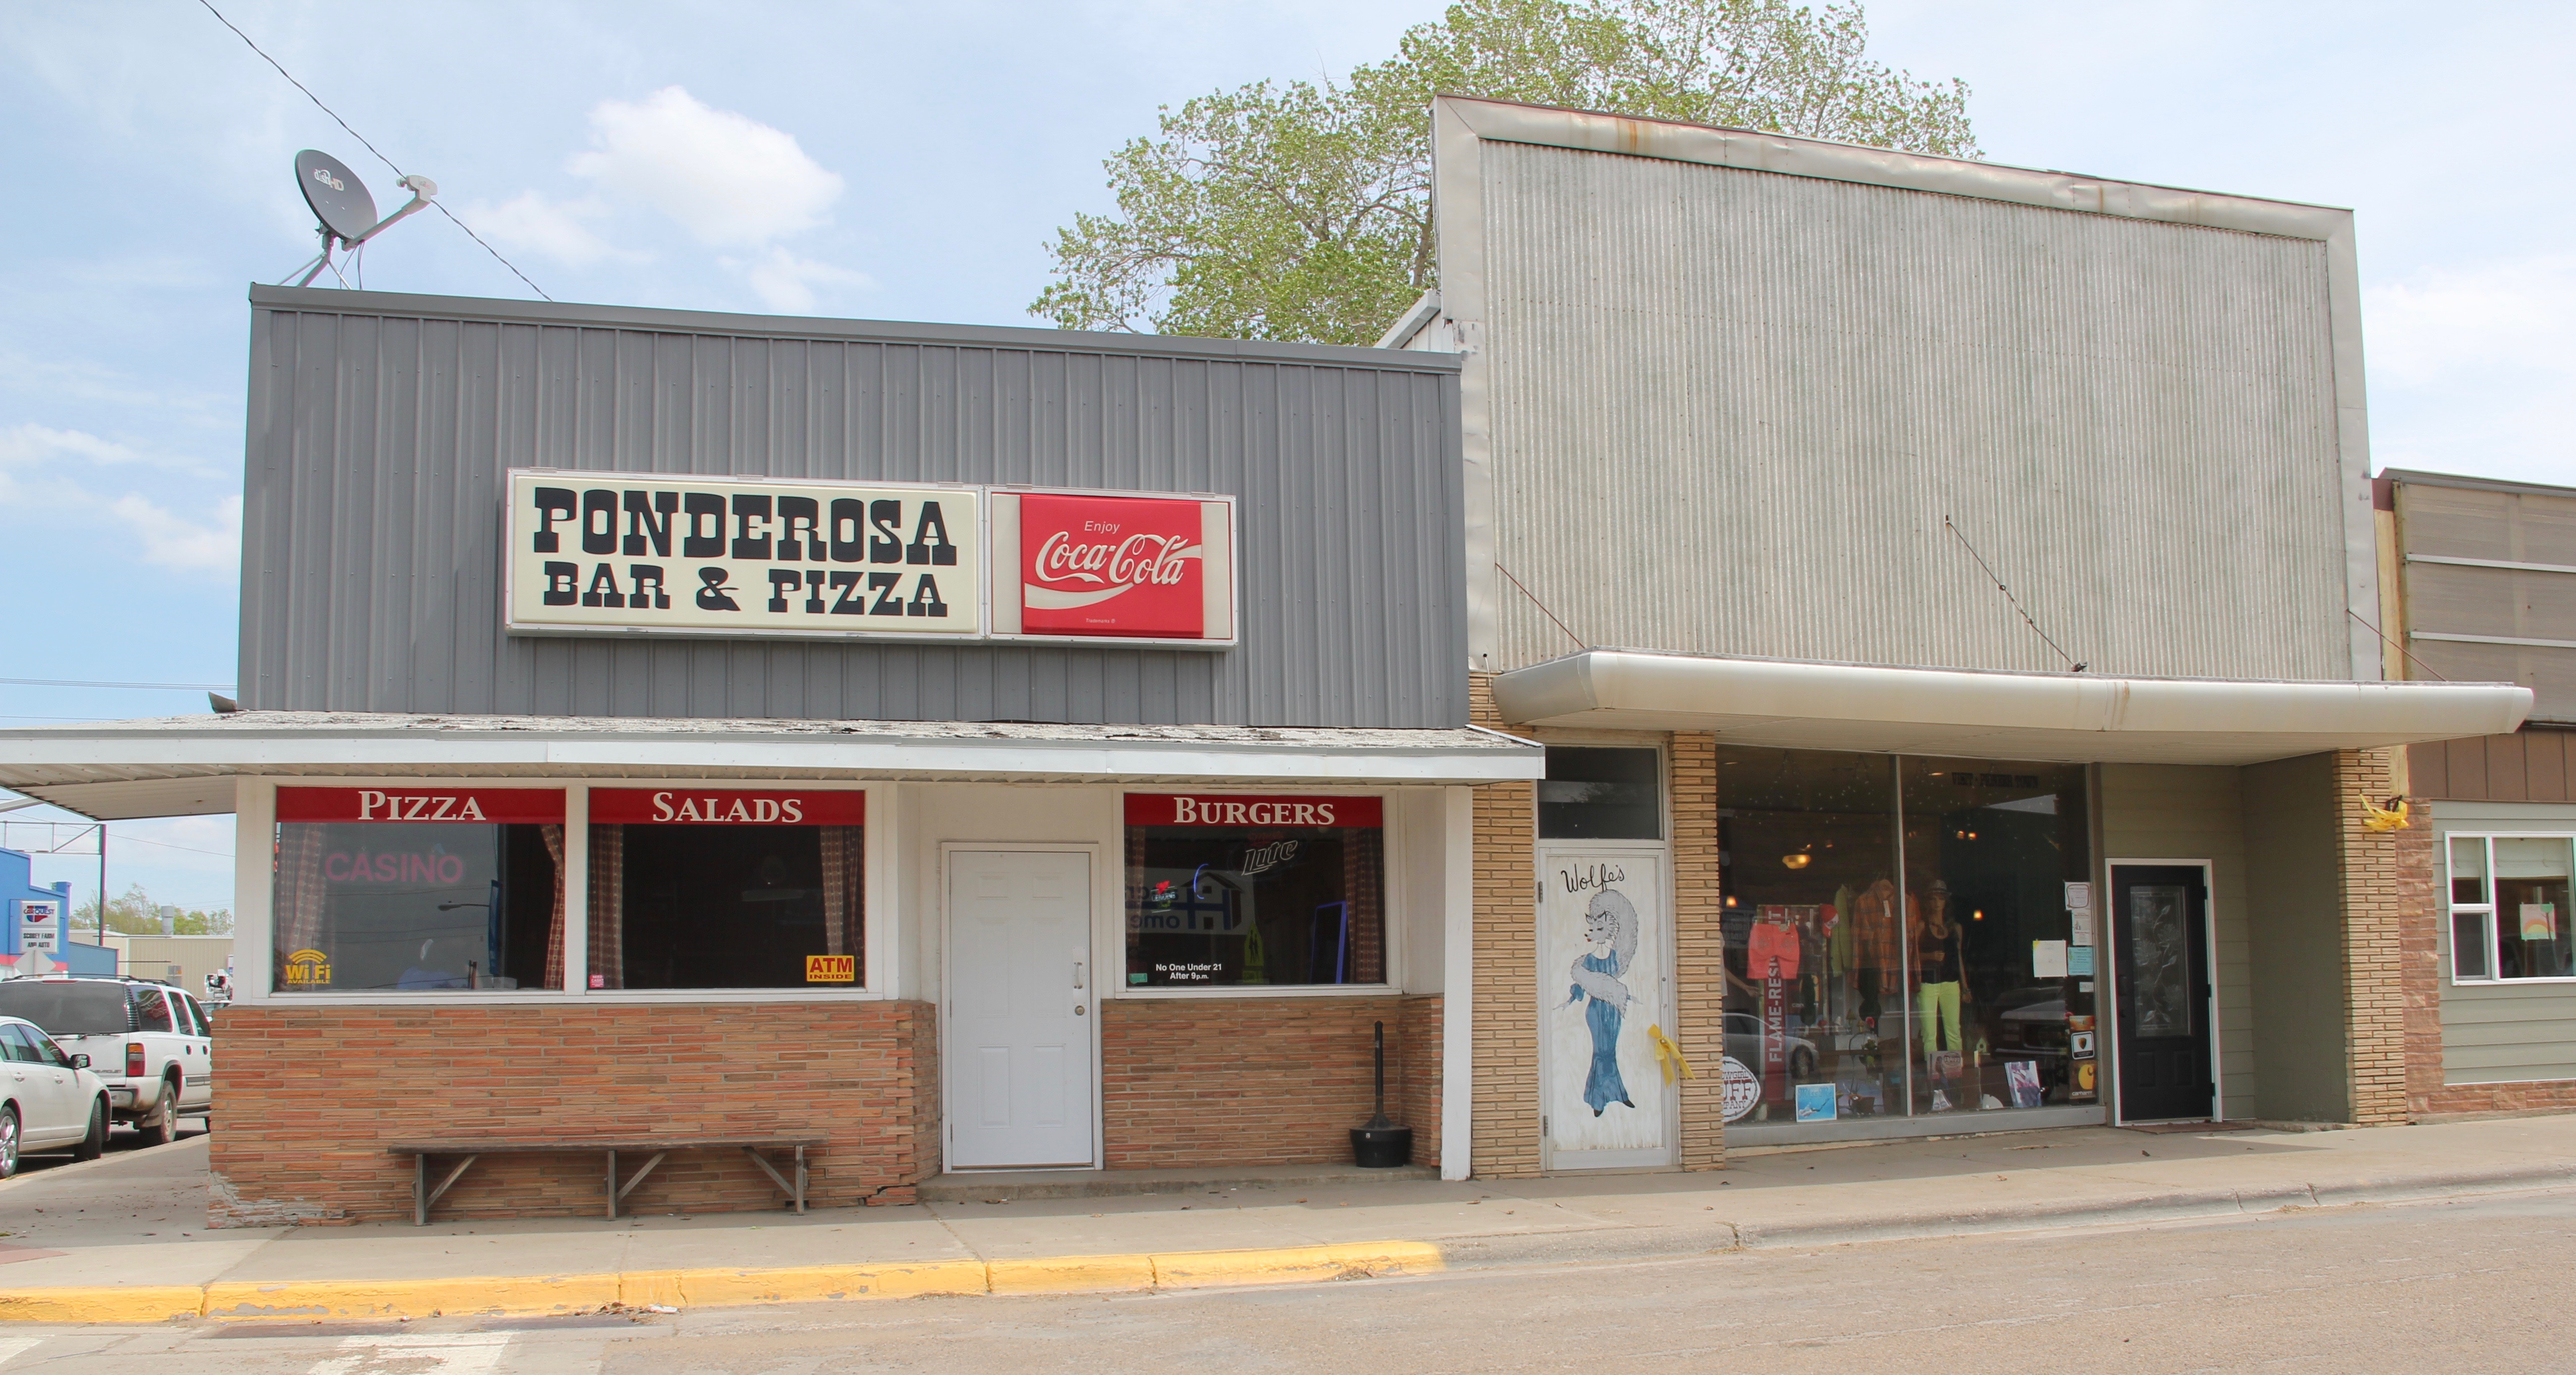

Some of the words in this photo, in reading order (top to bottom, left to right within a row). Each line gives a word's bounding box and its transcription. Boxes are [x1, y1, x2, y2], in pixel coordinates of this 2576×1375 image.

[534, 487, 957, 566] PONDEROSA
[1084, 521, 1120, 534] Enjoy
[1035, 531, 1189, 585] Coca-Cola
[544, 561, 670, 610] BAR
[696, 567, 741, 611] &
[768, 569, 948, 617] PIZZA
[358, 791, 486, 820] PIZZA
[653, 792, 803, 823] SALADS
[1173, 797, 1335, 825] BURGERS
[325, 853, 463, 883] CASINO
[1241, 840, 1298, 876] Lite
[1561, 863, 1625, 894] Wolfe's
[810, 958, 852, 972] ATM
[1721, 1071, 1749, 1079] OWGIRL
[1722, 1101, 1746, 1109] PANY
